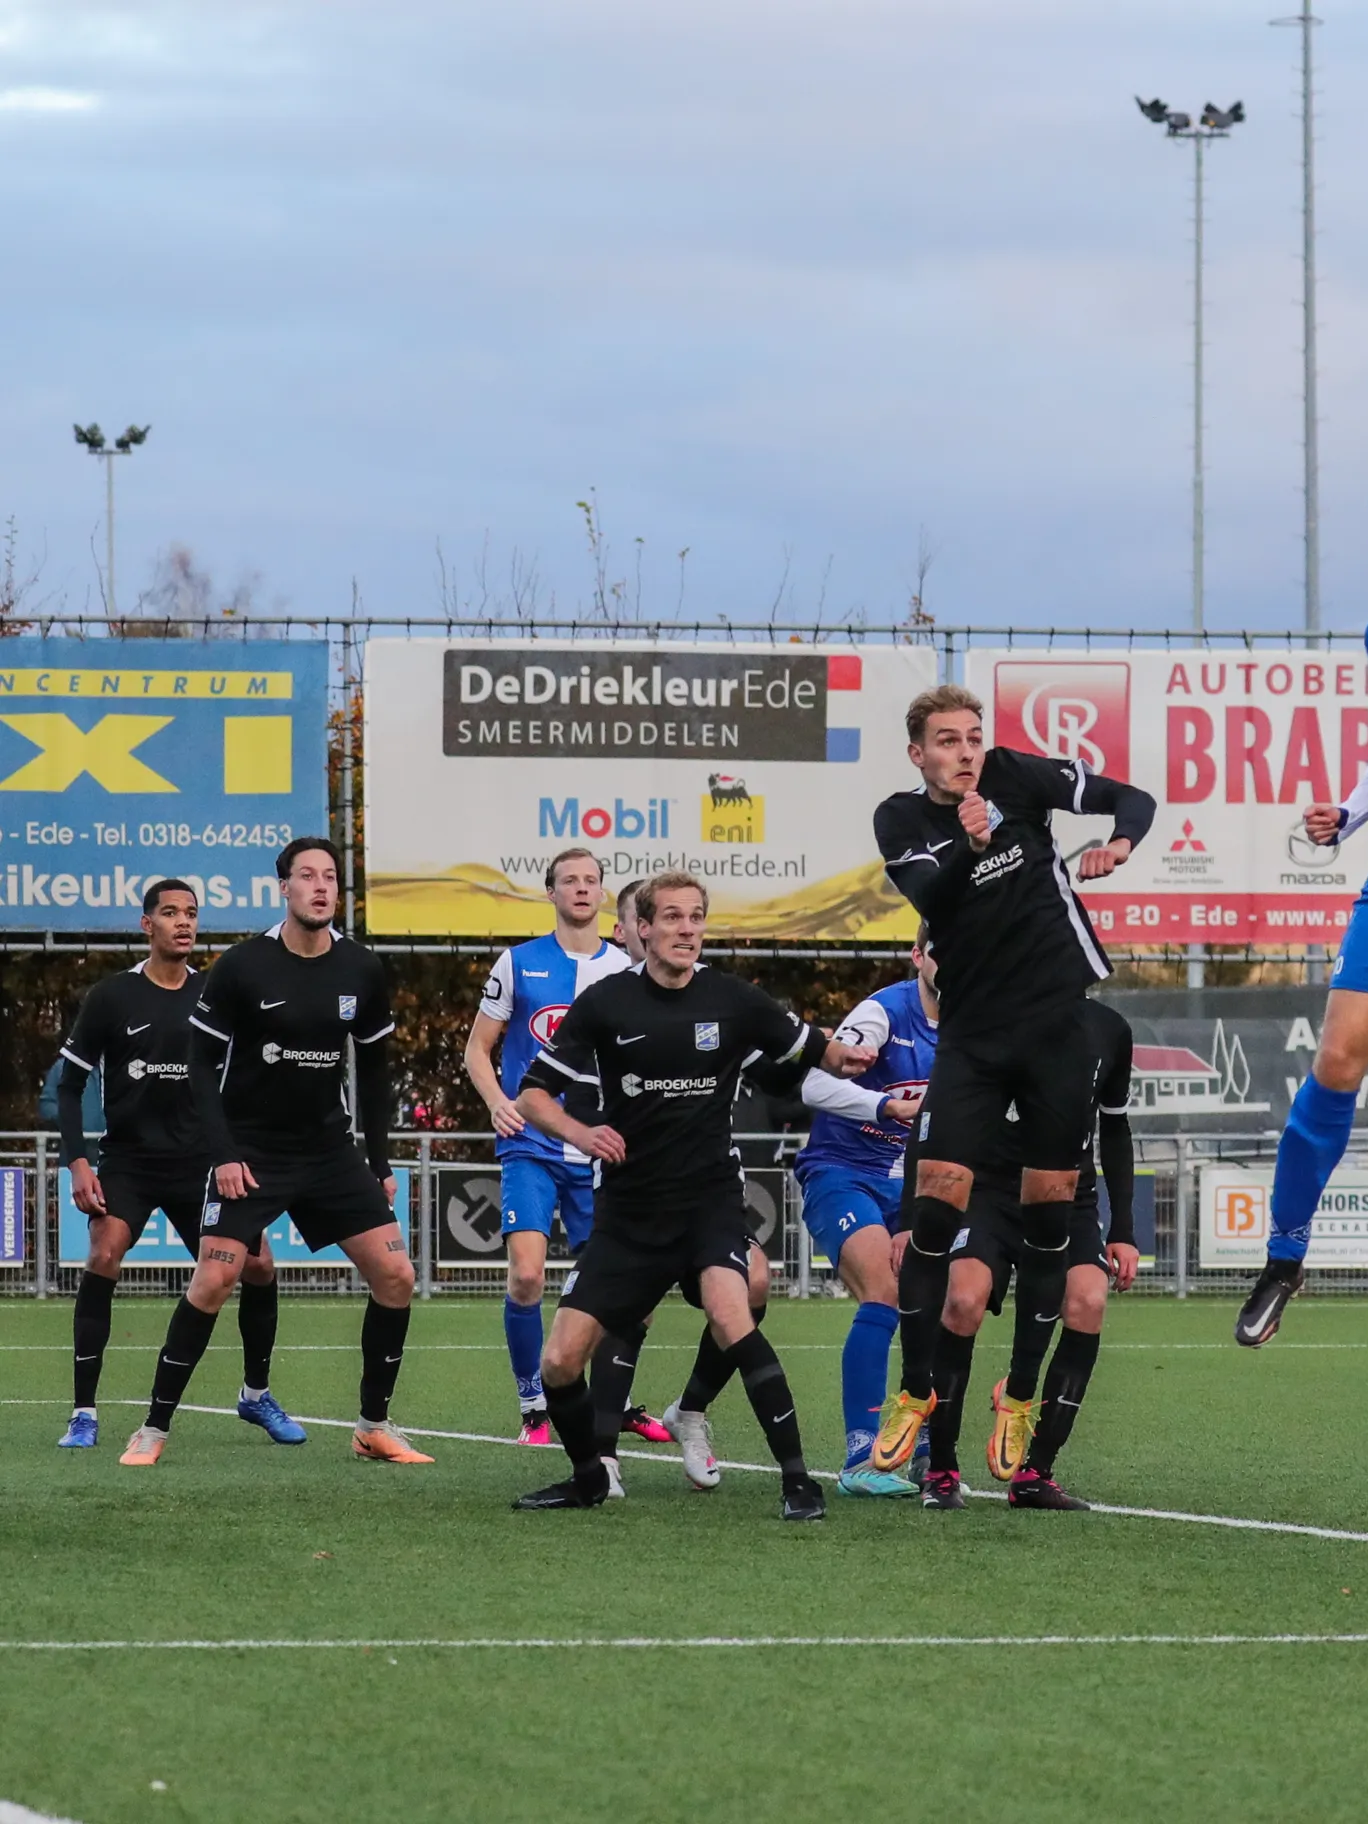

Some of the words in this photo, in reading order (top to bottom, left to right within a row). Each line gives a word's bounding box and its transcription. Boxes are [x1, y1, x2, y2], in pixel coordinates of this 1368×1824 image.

[458, 720, 740, 748] SMEERMIDDELEN
[539, 798, 669, 839] Mobil
[709, 817, 753, 844] eni
[26, 821, 74, 846] Ede
[93, 822, 133, 847] Tel.
[139, 823, 294, 848] 0318-642453
[500, 852, 806, 878] wweDriekleurEde.nl
[0, 864, 286, 908] ikeuks.n
[1088, 909, 1114, 930] eg
[1126, 905, 1161, 926] 20
[1190, 905, 1238, 926] Ede
[1266, 909, 1353, 927] www.a
[147, 1063, 189, 1074] BROEKH
[4, 1171, 15, 1258] VEENDERWEG
[507, 1210, 516, 1224] 3
[838, 1211, 857, 1231] 21
